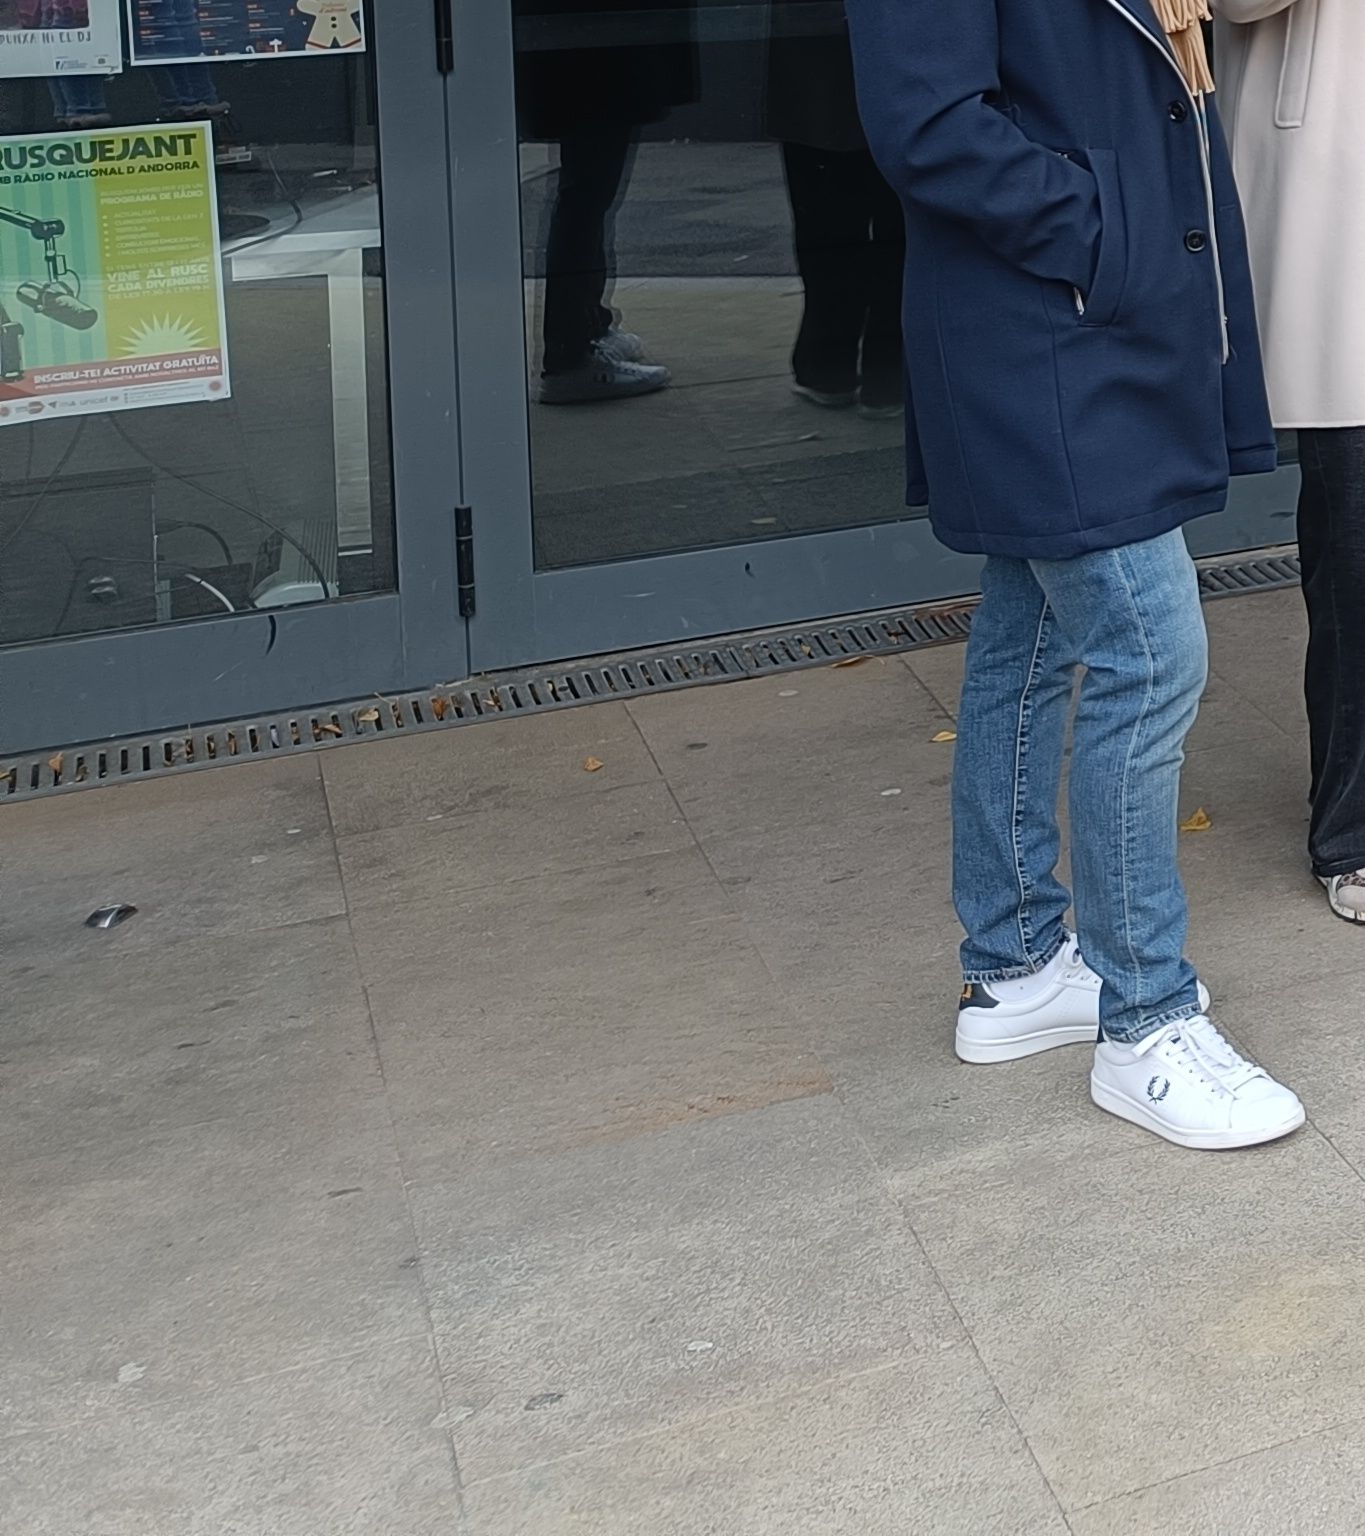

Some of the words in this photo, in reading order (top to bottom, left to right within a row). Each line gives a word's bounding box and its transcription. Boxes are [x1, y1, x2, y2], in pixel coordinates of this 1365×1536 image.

[58, 166, 125, 181] NACIONAL
[107, 270, 140, 282] VINE
[146, 267, 166, 279] AL
[170, 264, 209, 277] RUSC
[108, 282, 142, 293] CADA
[146, 274, 209, 289] DIVENDRES
[102, 362, 161, 376] ACTIVITAT
